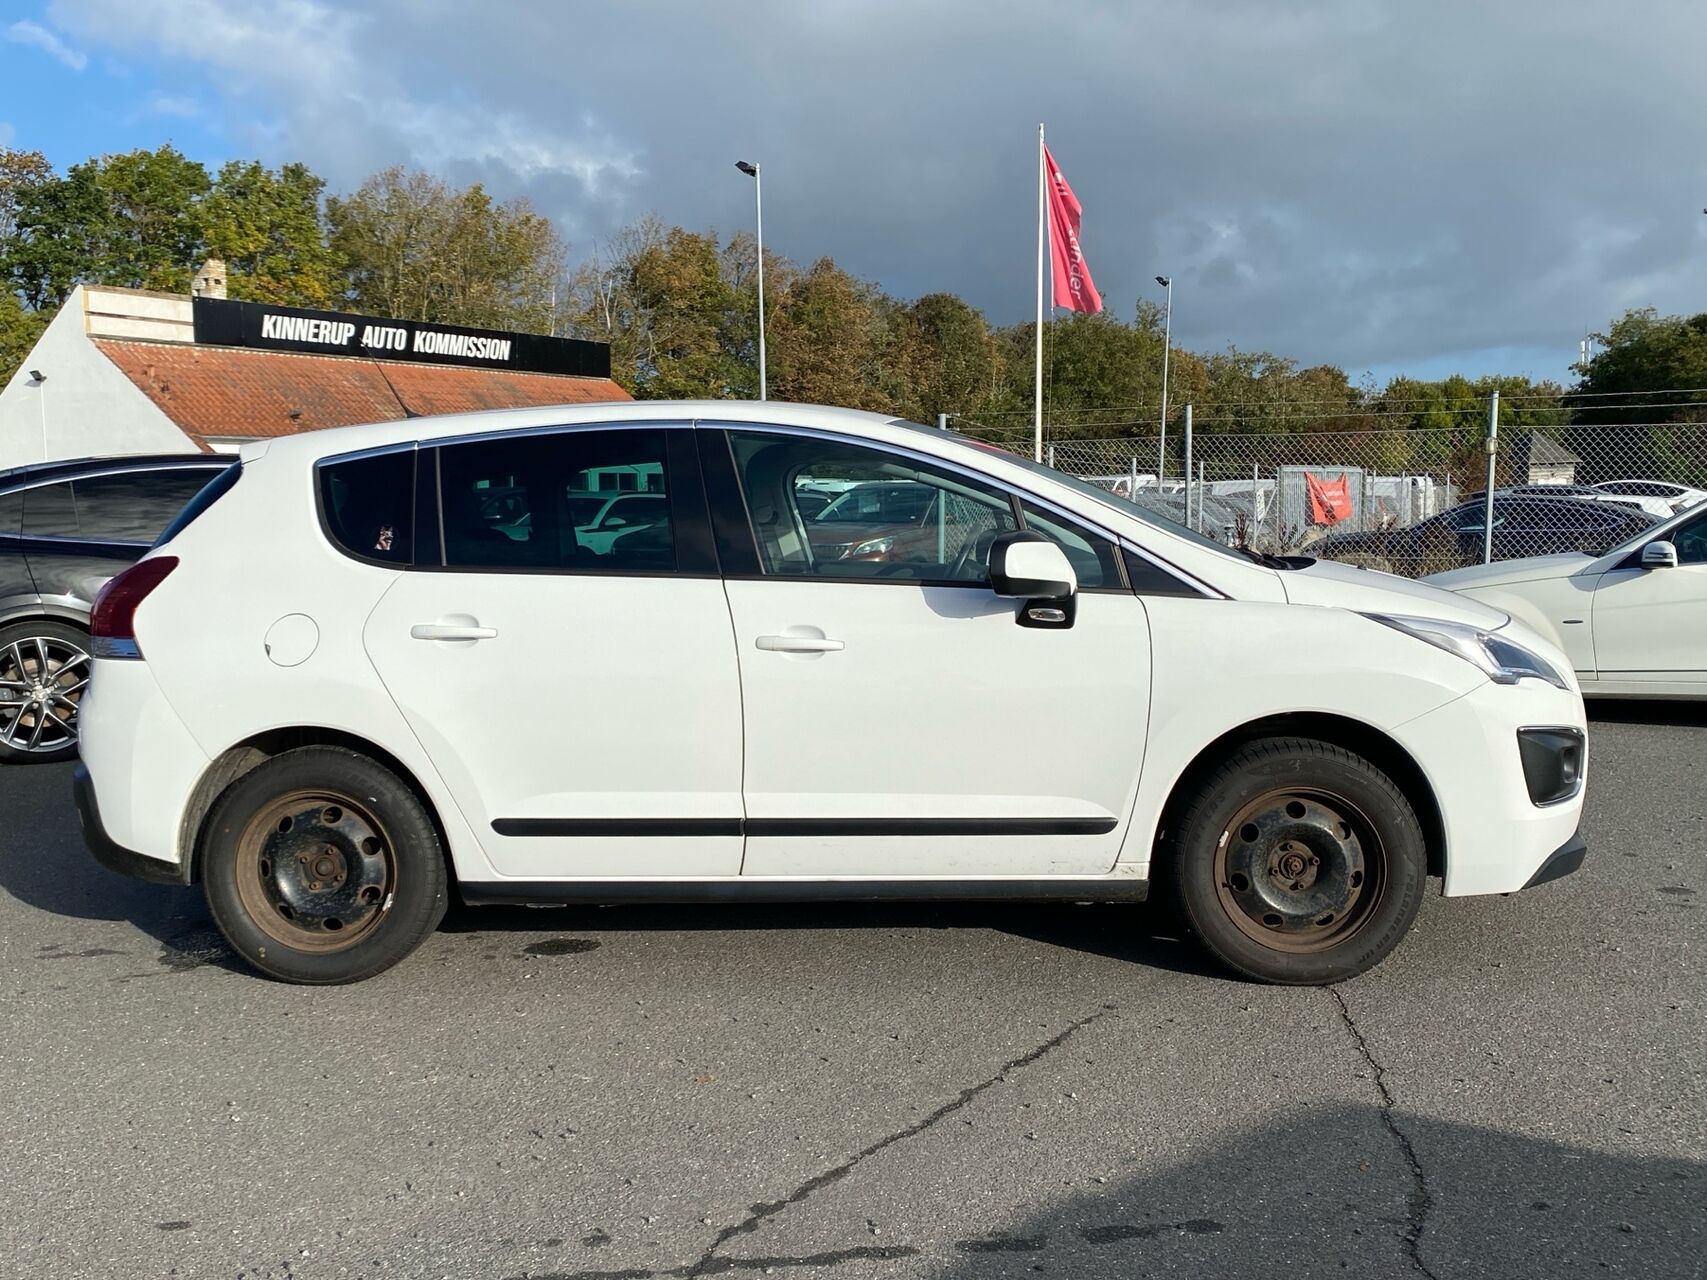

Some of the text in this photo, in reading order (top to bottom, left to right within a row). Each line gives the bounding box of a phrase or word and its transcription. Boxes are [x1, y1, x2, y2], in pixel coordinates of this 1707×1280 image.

[261, 314, 512, 361] KINNERUP AUTO KOMMISSION
